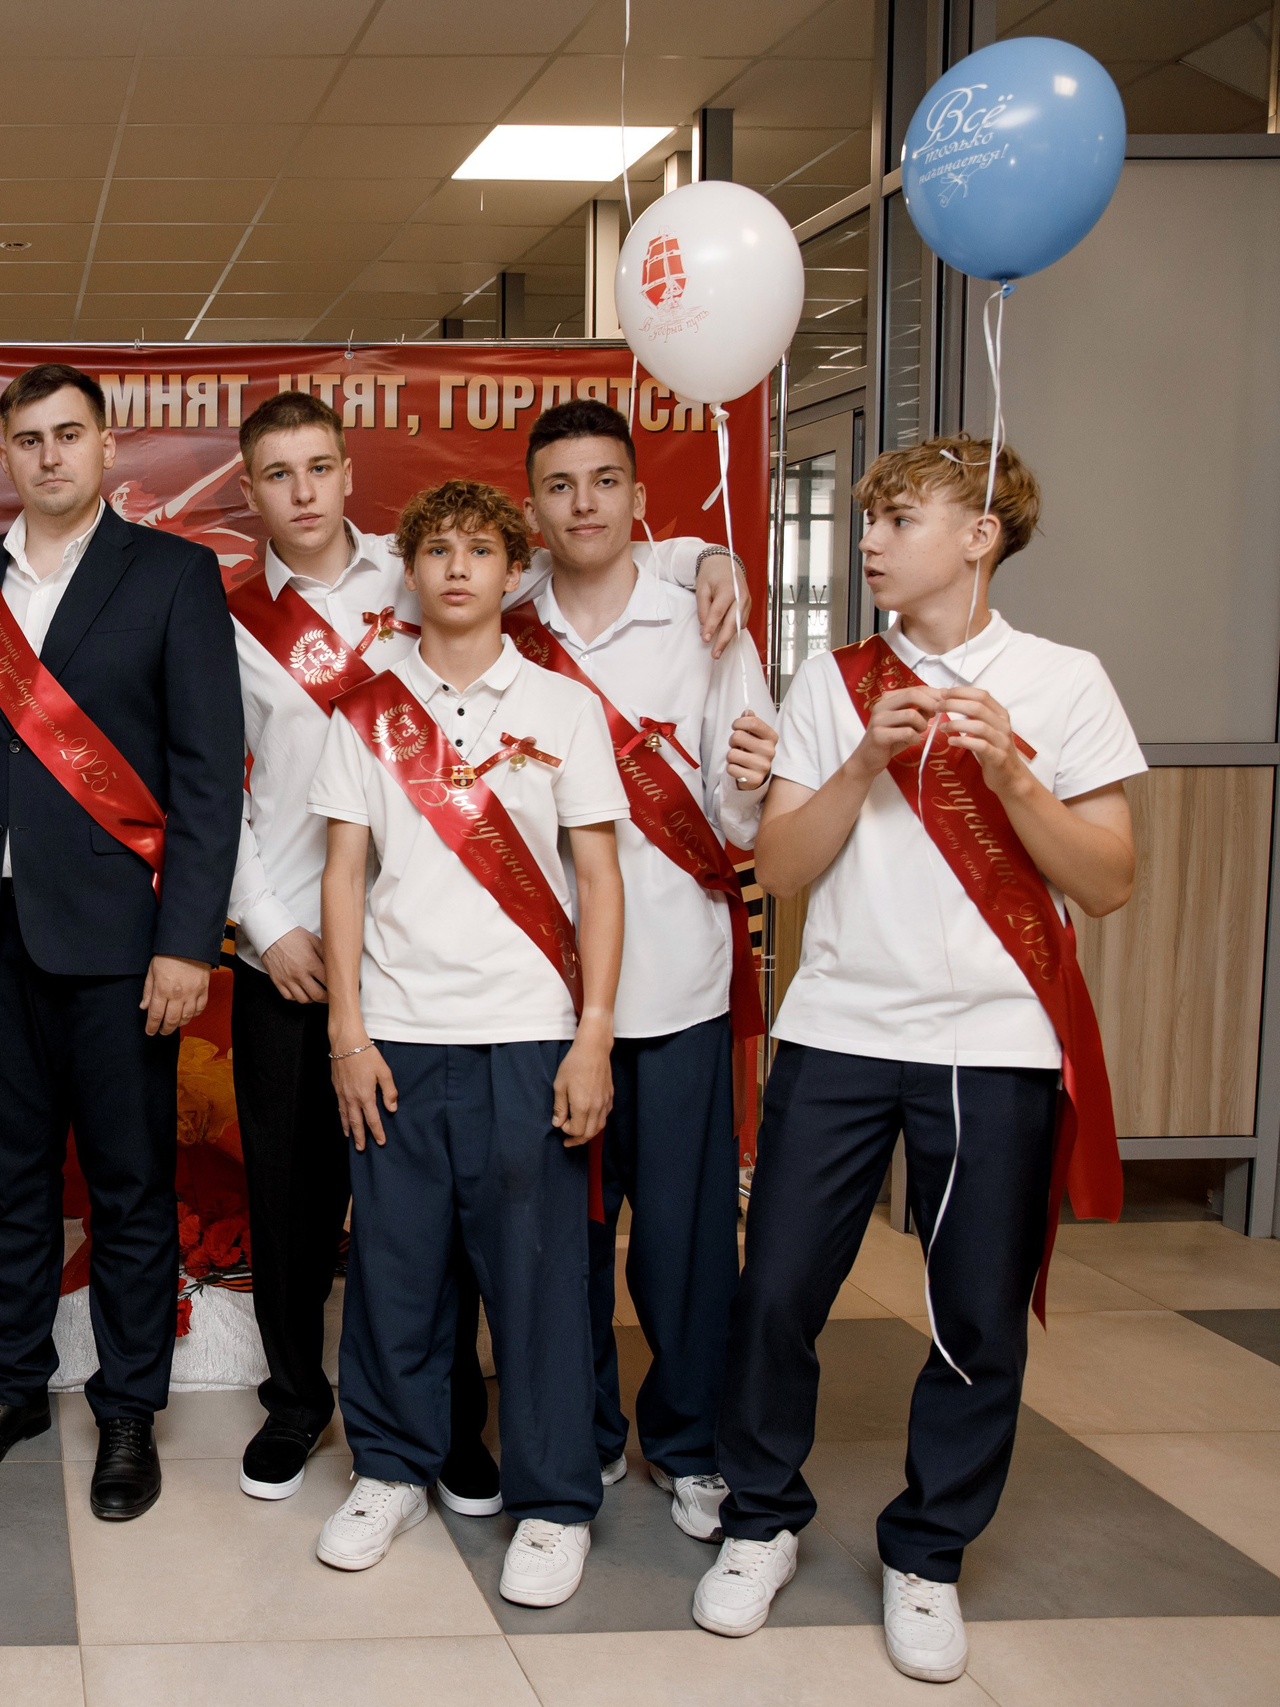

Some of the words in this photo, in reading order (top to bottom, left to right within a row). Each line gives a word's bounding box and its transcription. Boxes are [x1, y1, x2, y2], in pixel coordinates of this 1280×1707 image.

[912, 84, 1014, 159] Всё
[921, 125, 995, 164] только
[918, 143, 1009, 184] начинается!
[638, 316, 654, 332] В
[686, 310, 710, 334] путь
[99, 374, 249, 428] МНЯТ
[60, 737, 118, 793] 2025
[408, 754, 541, 898] Выпускник
